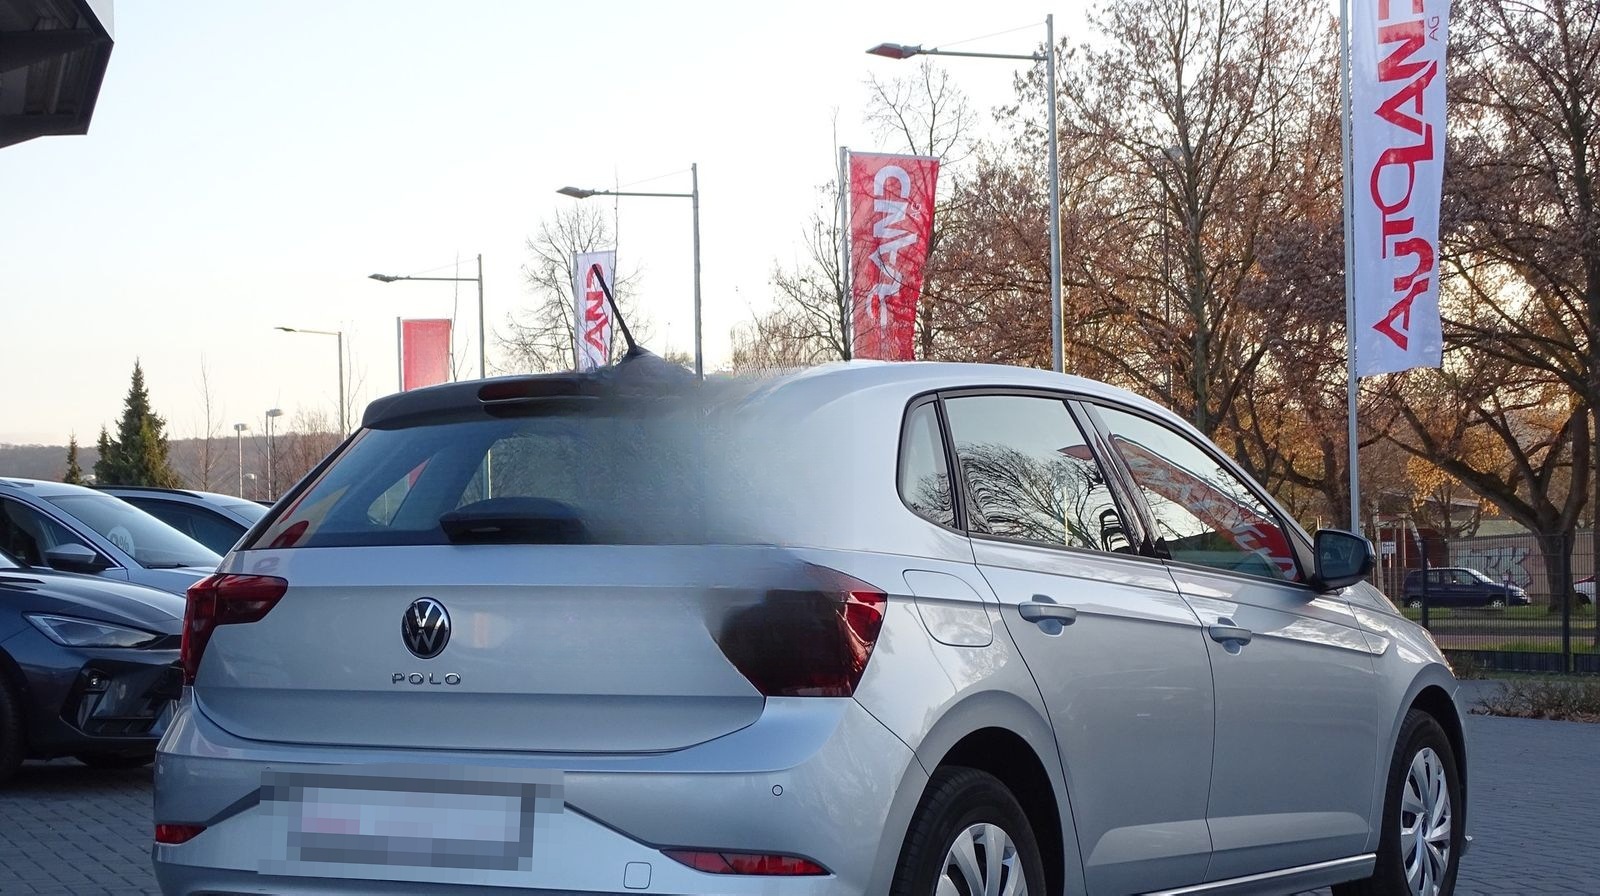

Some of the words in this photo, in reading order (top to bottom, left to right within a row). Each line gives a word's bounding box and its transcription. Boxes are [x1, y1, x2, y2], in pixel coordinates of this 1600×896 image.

[1427, 15, 1440, 41] AG
[910, 203, 922, 221] AG
[402, 597, 451, 659] VW
[391, 672, 461, 685] POLO
